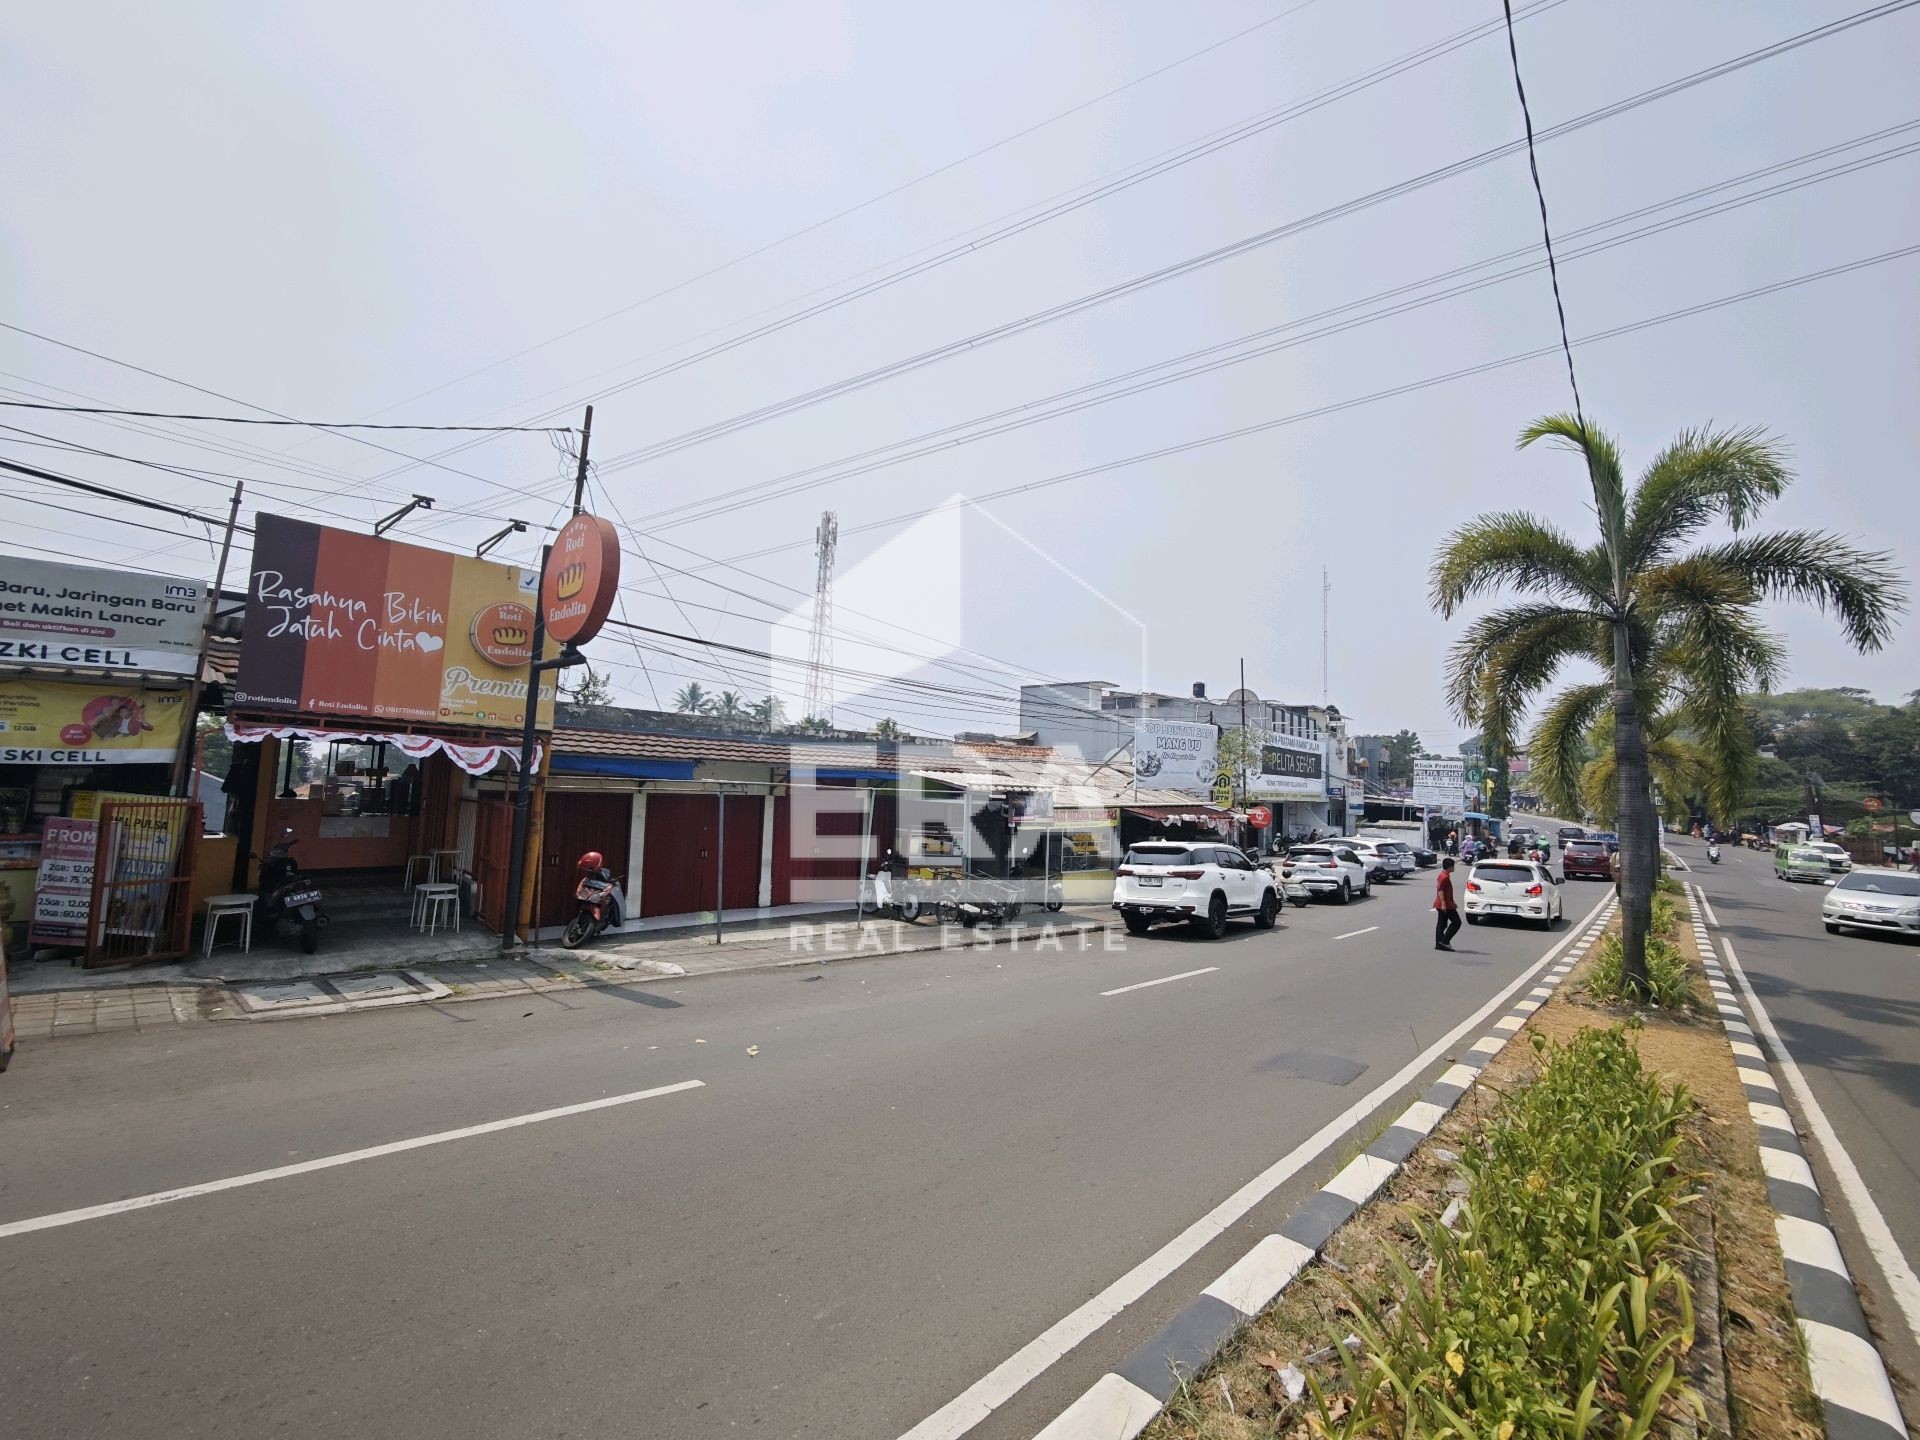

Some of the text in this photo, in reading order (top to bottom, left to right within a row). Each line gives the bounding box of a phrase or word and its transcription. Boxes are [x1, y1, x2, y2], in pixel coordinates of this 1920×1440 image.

[565, 532, 585, 552] Roti
[55, 588, 146, 608] Jaringan
[152, 598, 196, 614] Baru
[253, 570, 445, 624] Rasanya Bikin
[0, 602, 167, 627] et Makin Lancar
[499, 610, 522, 622] Roti
[549, 601, 587, 622] Endolita
[3, 619, 21, 627] Beli
[41, 623, 79, 632] aktifkan
[266, 605, 416, 653] Jatuh Cinta
[60, 646, 138, 667] CELL
[487, 645, 533, 657] Endolita
[247, 694, 297, 705] rotiendolita
[318, 700, 368, 711] Roti Endolita
[1143, 722, 1160, 734] SOP
[1161, 724, 1195, 737] BUNTUT
[1156, 736, 1187, 751] MANG
[0, 749, 106, 762] SKI CELL
[1272, 752, 1316, 774] PELITA SEHAT
[47, 828, 98, 844] PROM
[73, 865, 95, 874] 12.00
[69, 875, 93, 884] 75.00
[68, 899, 90, 908] 12.00
